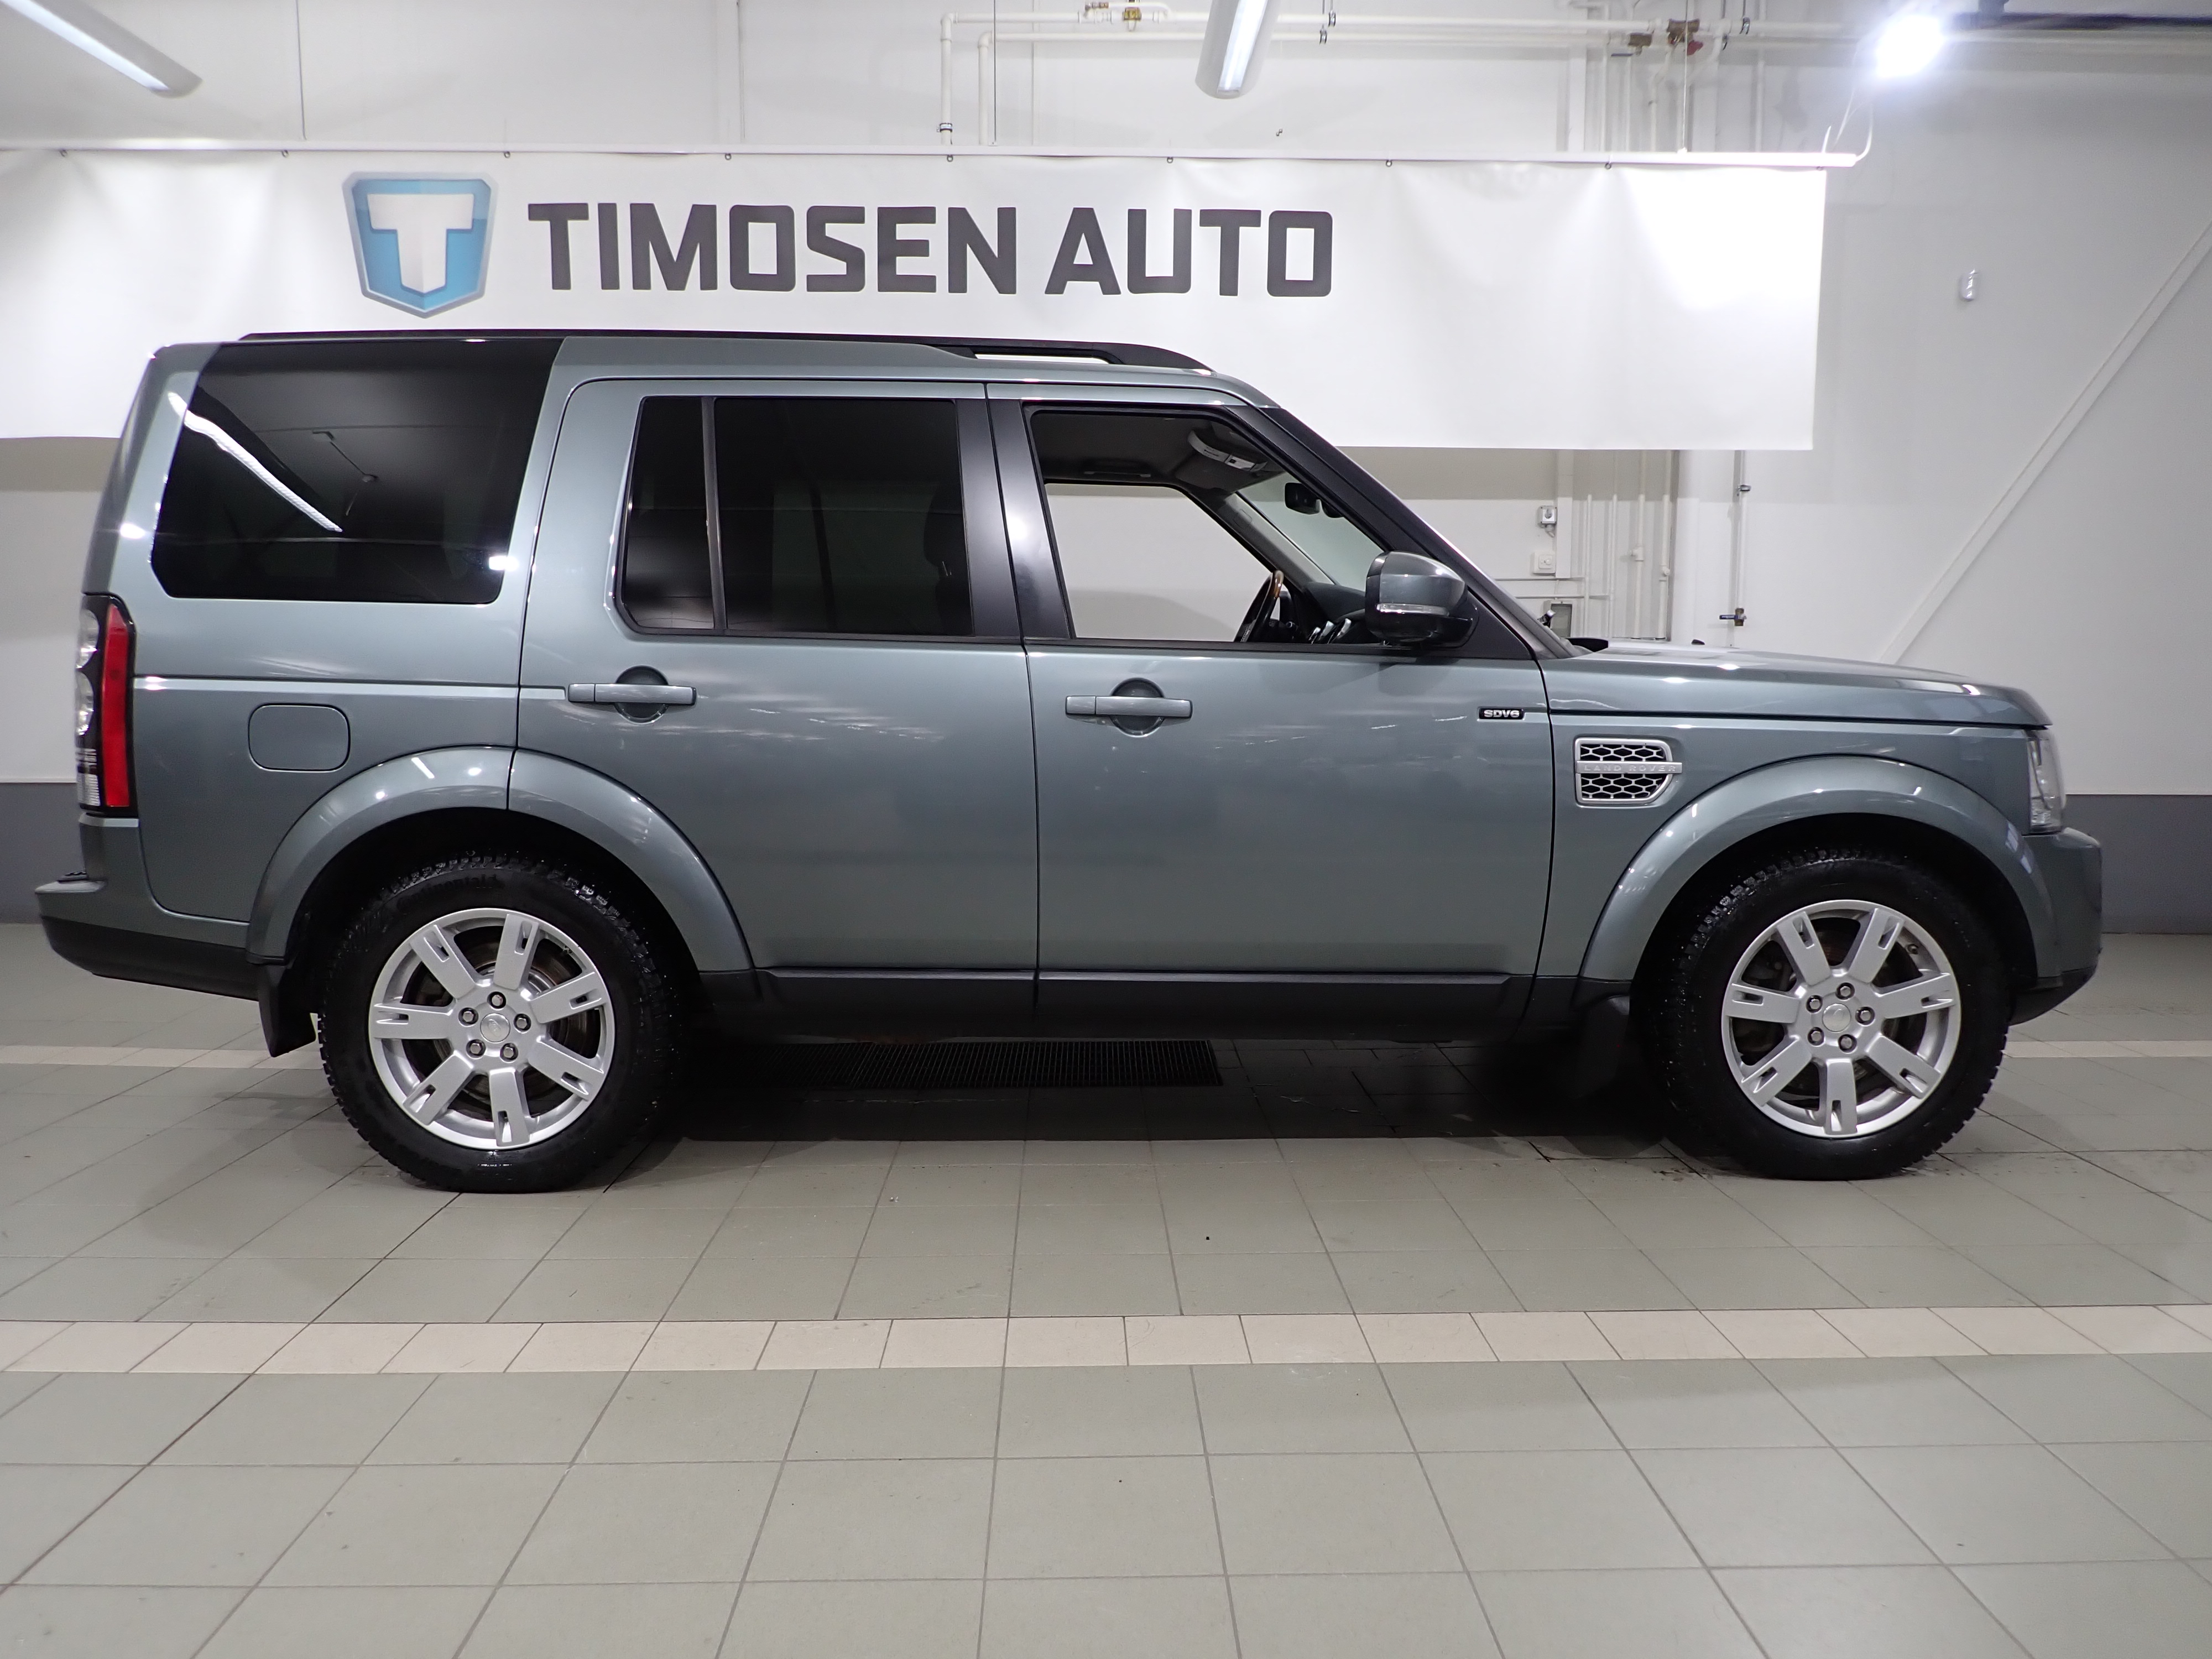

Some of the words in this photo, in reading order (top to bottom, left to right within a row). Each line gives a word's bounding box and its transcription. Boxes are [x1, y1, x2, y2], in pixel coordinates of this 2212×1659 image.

[528, 202, 1017, 295] TIMOSEN
[1045, 207, 1333, 297] AUTO
[1484, 709, 1520, 718] SDV6
